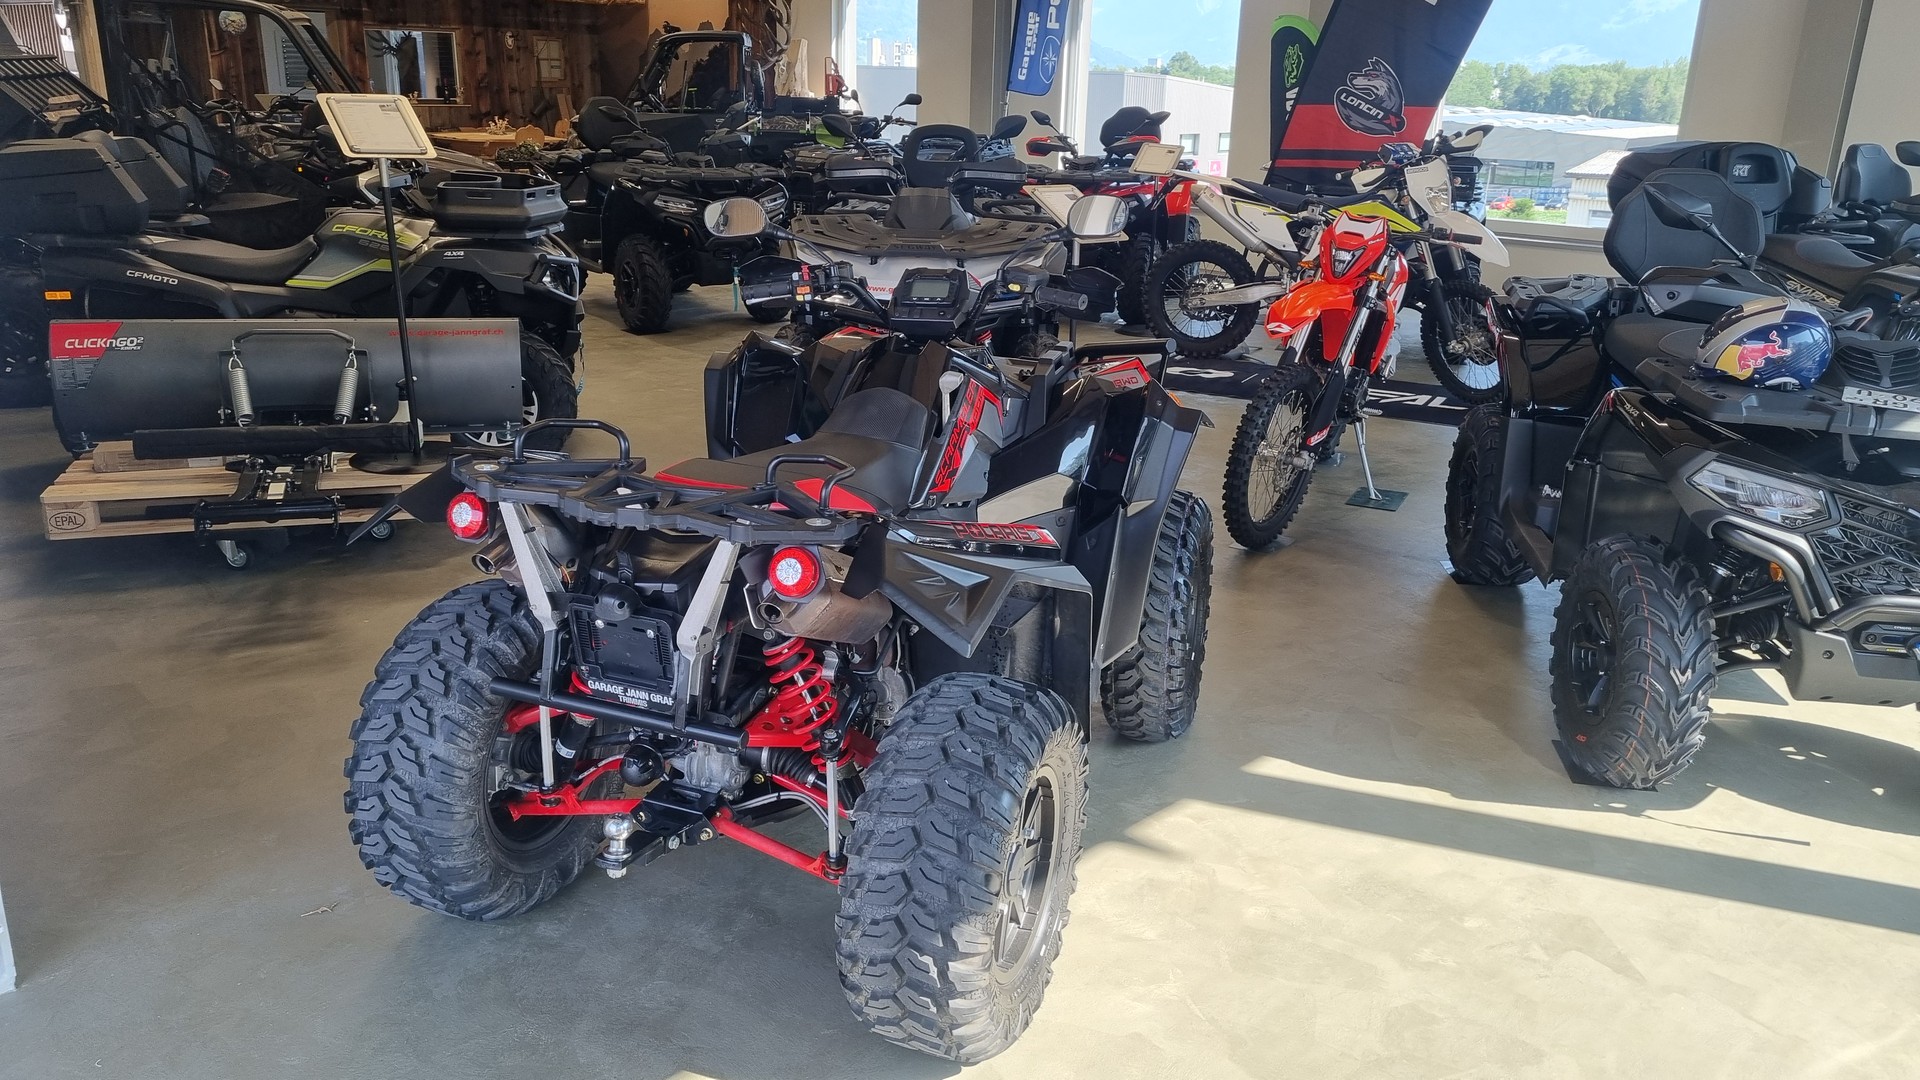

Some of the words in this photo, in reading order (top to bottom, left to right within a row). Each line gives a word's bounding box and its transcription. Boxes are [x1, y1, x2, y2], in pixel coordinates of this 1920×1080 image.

[1018, 11, 1035, 81] Garage
[126, 270, 179, 285] CFMOTO
[54, 515, 81, 527] EPAL
[951, 522, 1037, 542] POLARIS
[587, 680, 625, 697] GARAGE
[625, 687, 649, 701] JANN
[649, 693, 675, 706] GRAF
[618, 694, 648, 707] TRIMMIS
